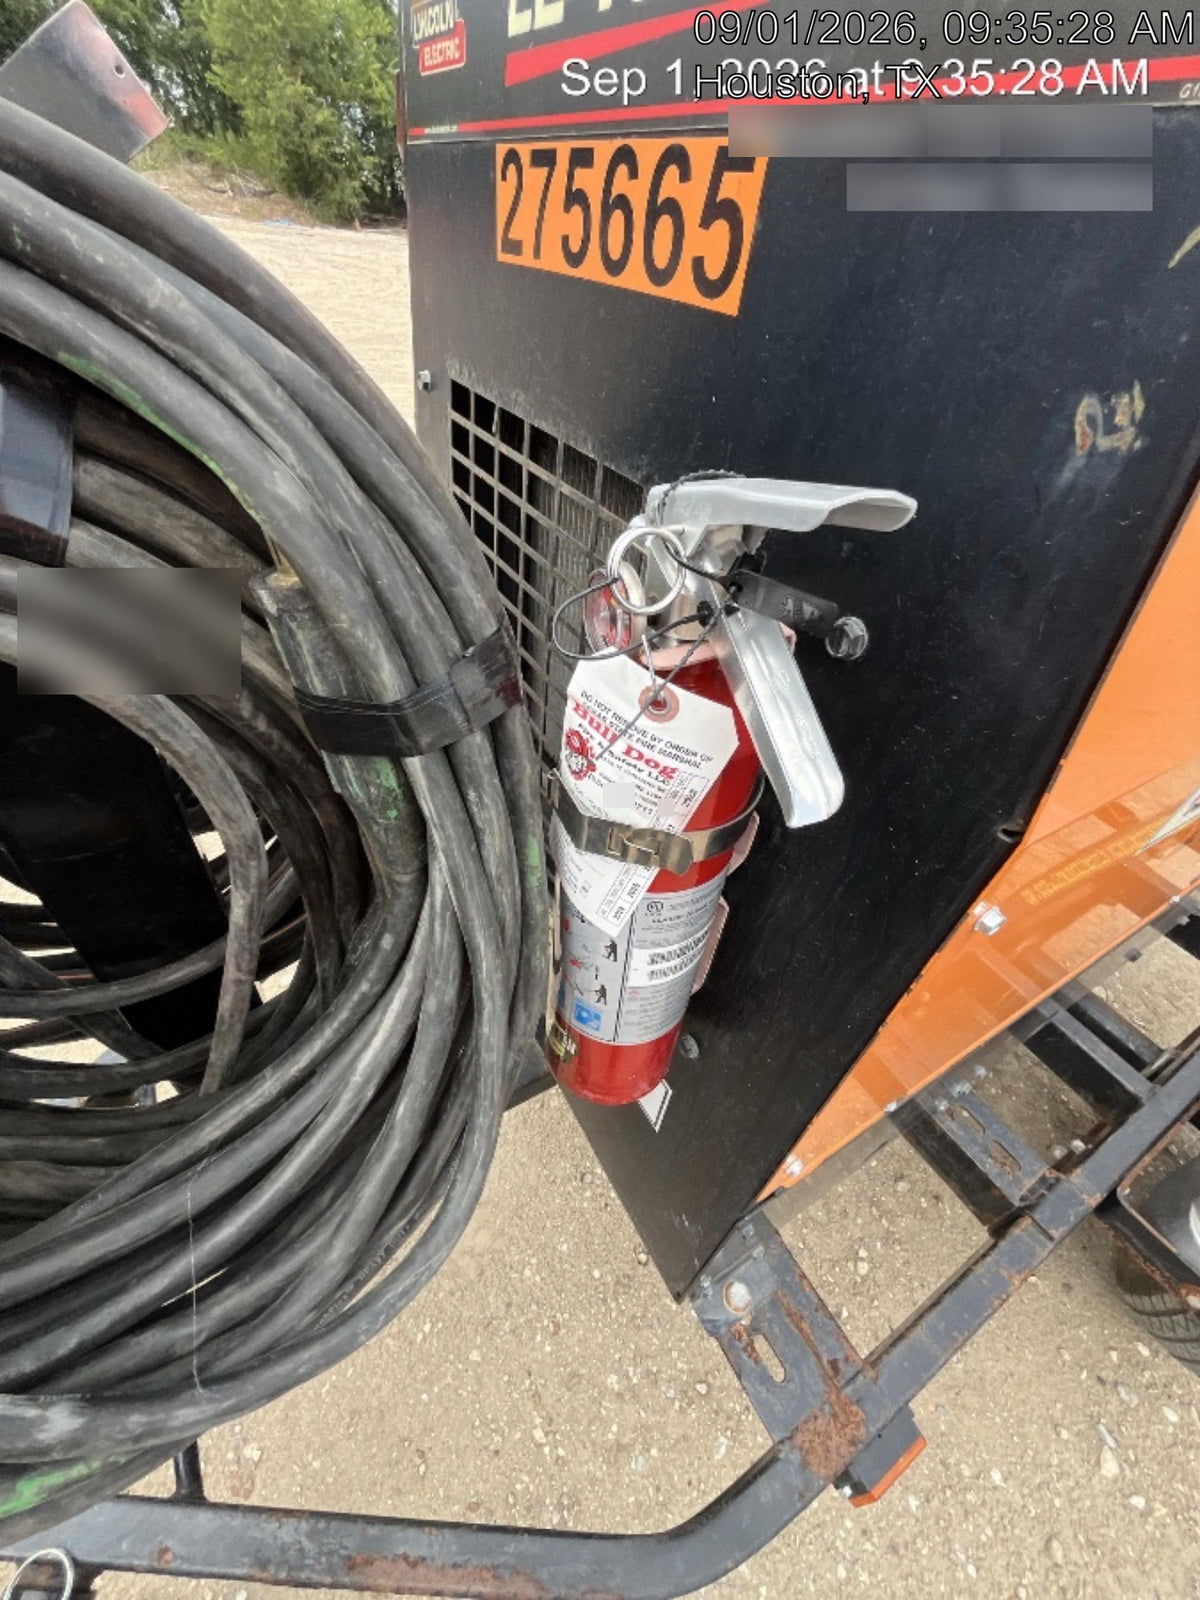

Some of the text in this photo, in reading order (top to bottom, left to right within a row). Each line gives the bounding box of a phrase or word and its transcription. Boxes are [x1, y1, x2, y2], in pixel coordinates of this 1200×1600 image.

[414, 0, 455, 41] LINCOLN
[424, 37, 460, 67] ELECTRIC
[500, 142, 756, 300] 275665
[573, 701, 620, 745] Bull
[621, 743, 680, 781] Dog
[580, 690, 593, 703] DO
[594, 699, 612, 715] NOT
[650, 733, 664, 745] BY
[664, 740, 699, 759] ORDER
